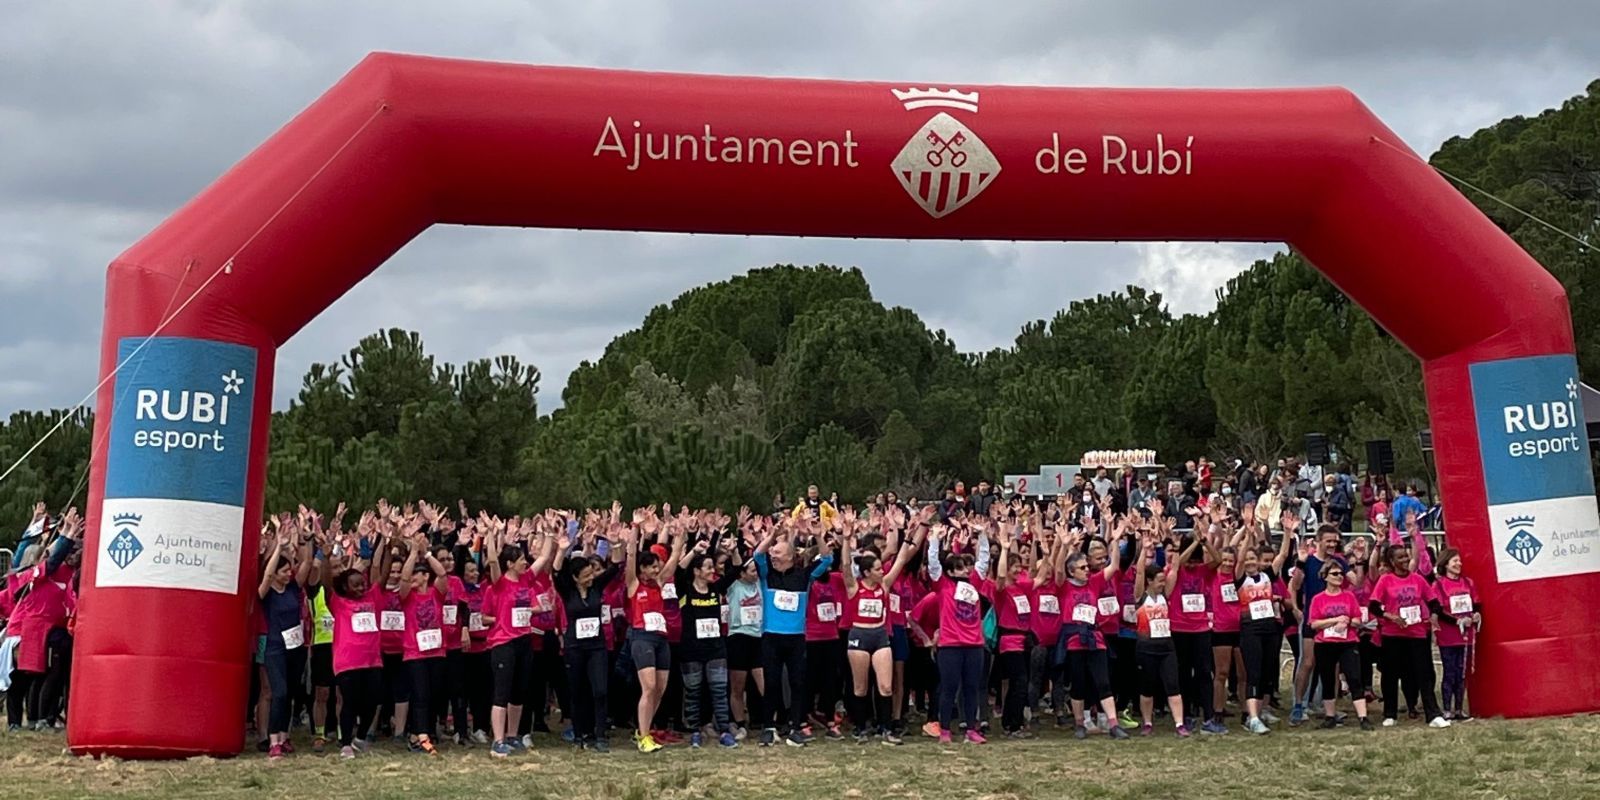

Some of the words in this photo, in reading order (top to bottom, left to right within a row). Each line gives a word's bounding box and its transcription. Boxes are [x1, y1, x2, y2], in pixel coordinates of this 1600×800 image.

[593, 116, 859, 170] Ajuntament
[1035, 132, 1088, 174] de
[1102, 133, 1194, 175] Rubí
[134, 429, 225, 453] esport
[1508, 432, 1580, 459] esport
[1018, 478, 1027, 493] 2
[1055, 473, 1063, 488] 1
[154, 533, 234, 552] Ajuntament
[1552, 543, 1563, 558] de
[1569, 541, 1591, 556] Rubí
[152, 551, 172, 567] de
[175, 552, 207, 568] Rubí
